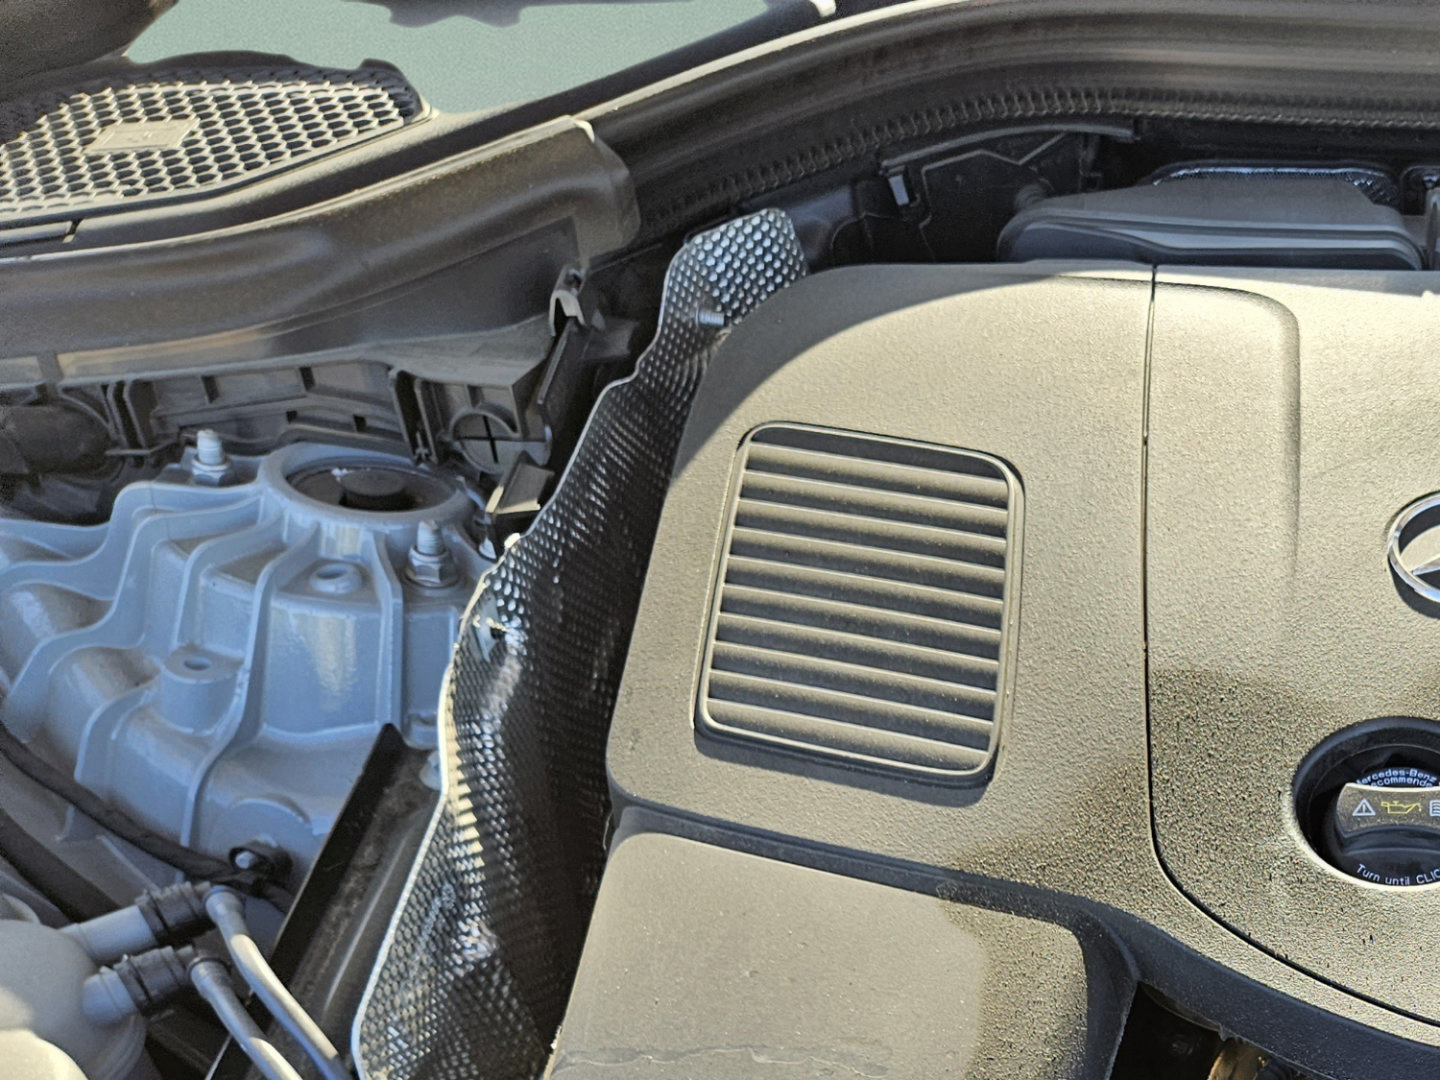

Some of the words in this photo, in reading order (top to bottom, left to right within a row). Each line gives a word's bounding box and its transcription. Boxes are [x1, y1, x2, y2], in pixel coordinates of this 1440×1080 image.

[1371, 776, 1433, 788] ecommende
[1356, 863, 1381, 882] Turn
[1384, 876, 1410, 886] until
